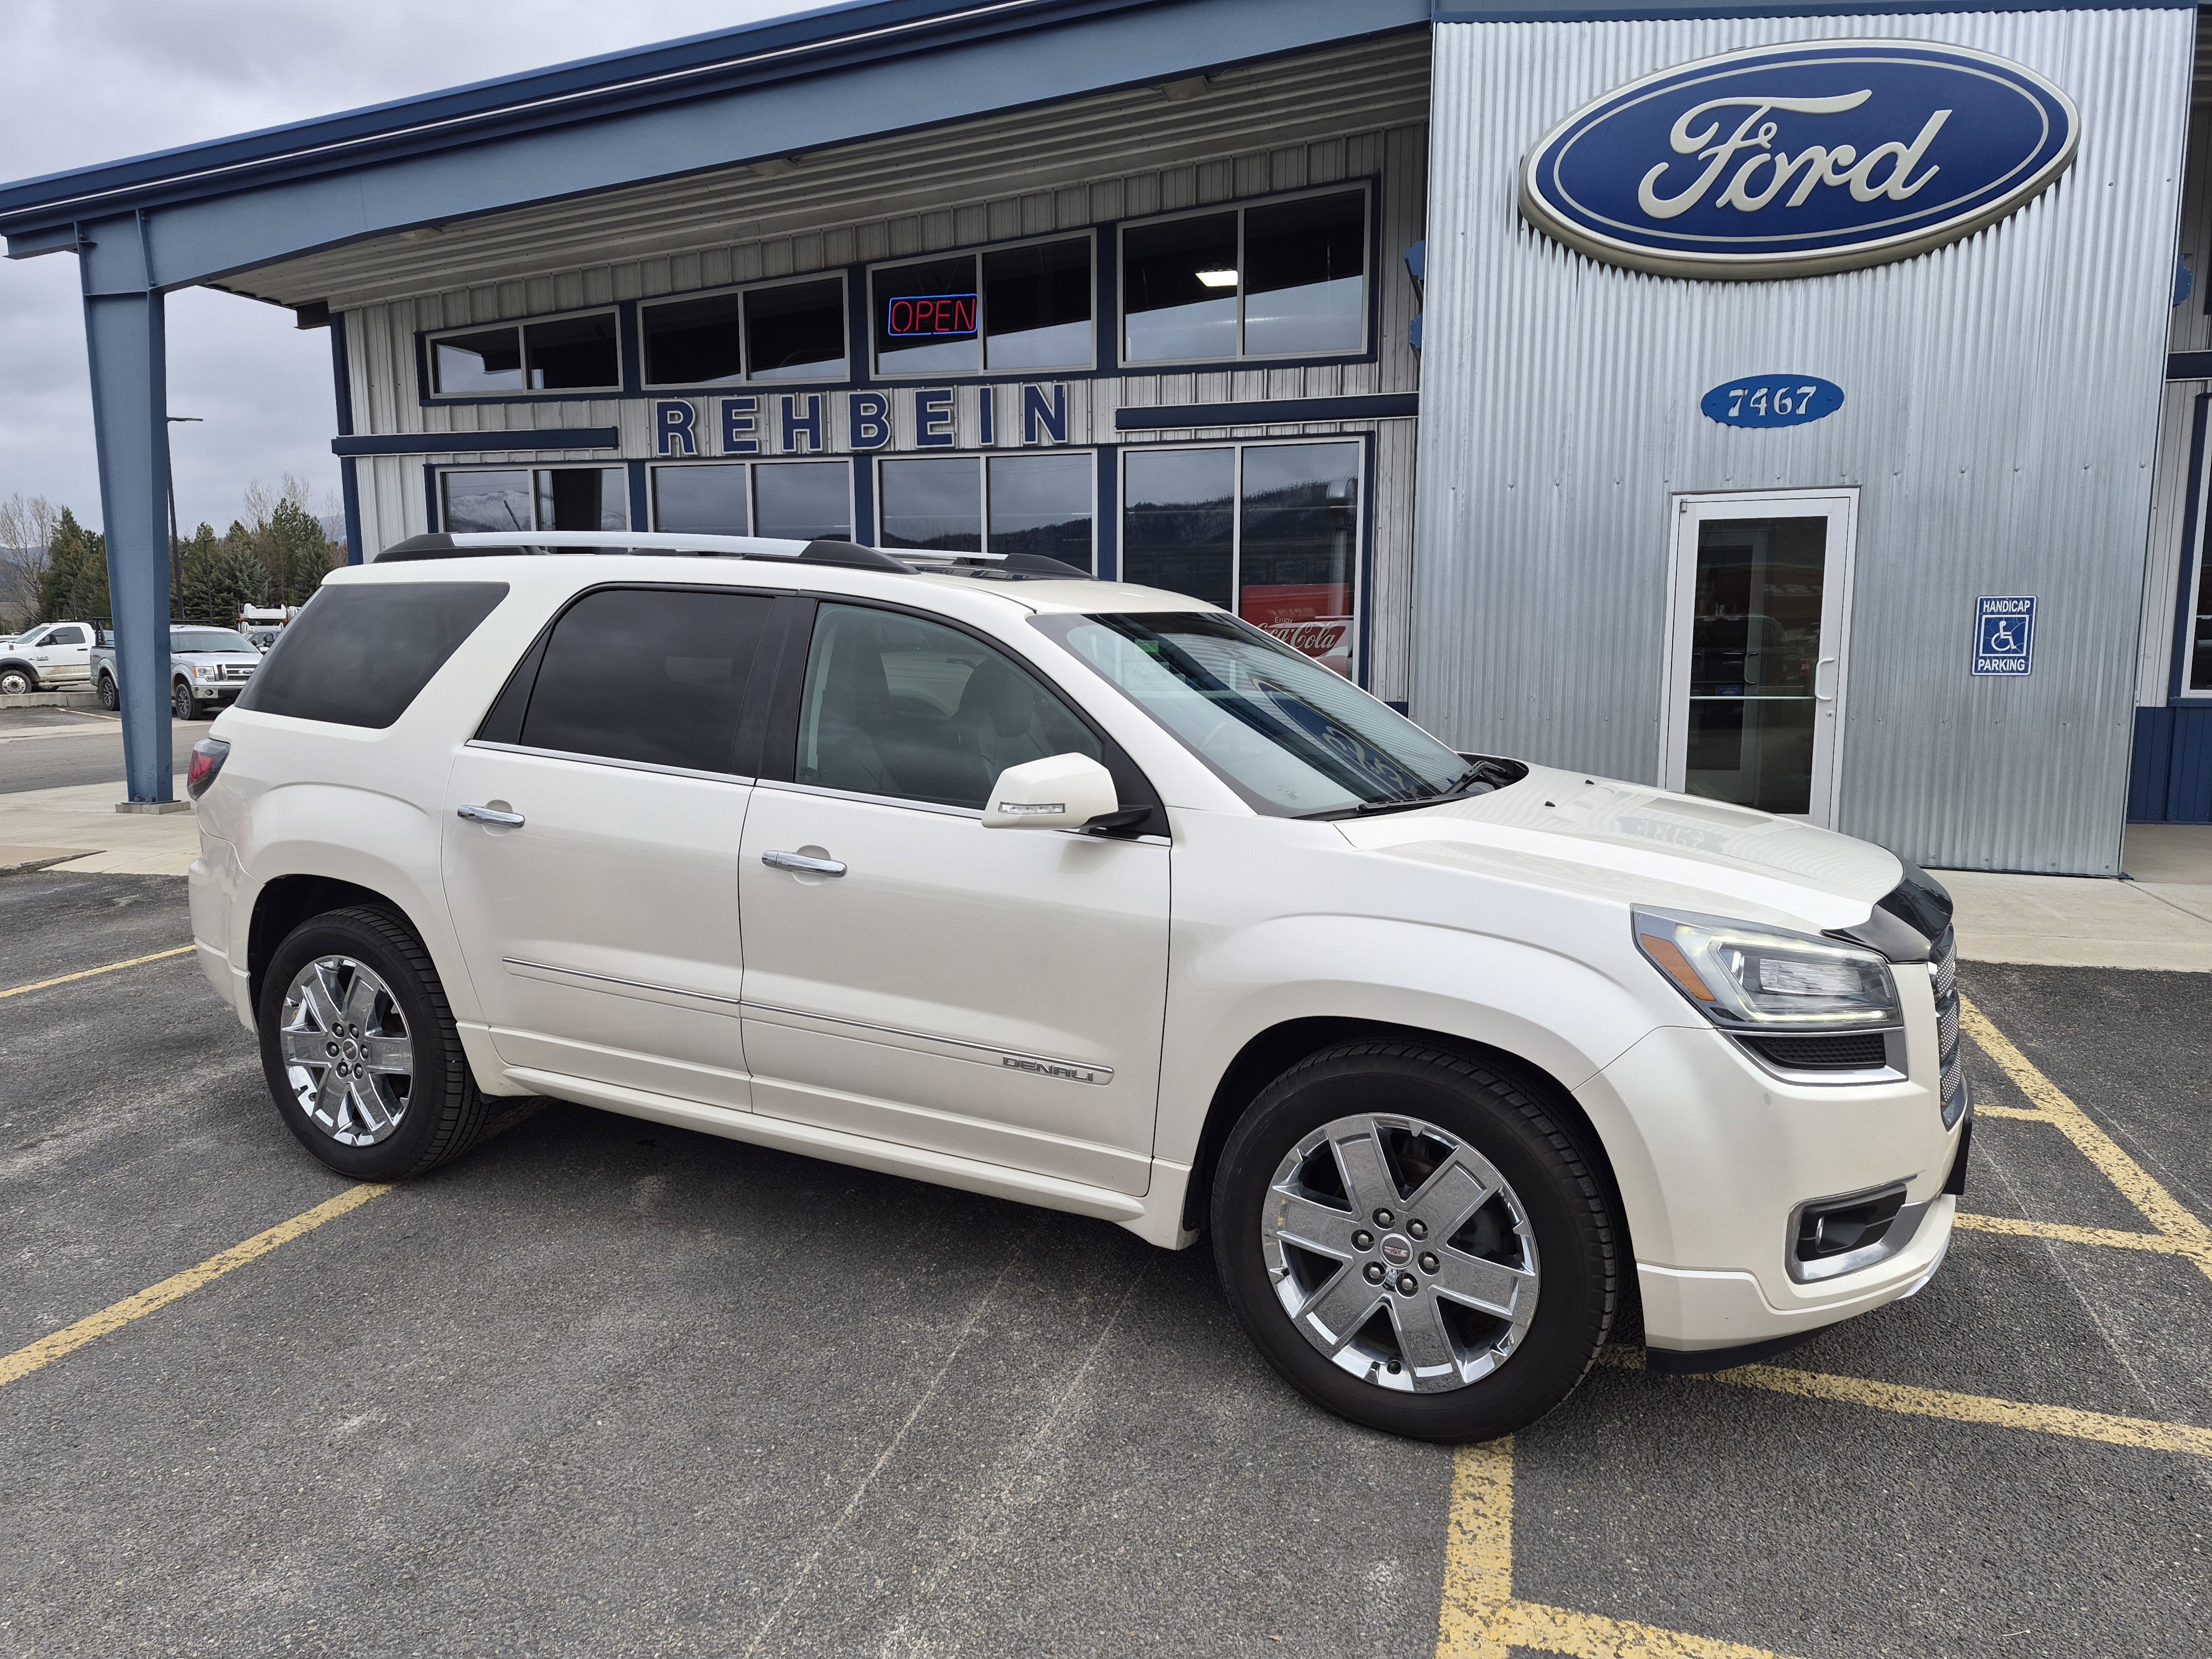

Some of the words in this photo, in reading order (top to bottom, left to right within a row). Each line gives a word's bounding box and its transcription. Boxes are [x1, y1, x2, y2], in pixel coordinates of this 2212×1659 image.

[1638, 88, 1953, 218] Ford
[891, 299, 977, 333] OPEN
[1726, 385, 1818, 416] 7467
[655, 382, 1068, 456] REHBEIN
[1983, 600, 2031, 612] HANDICAP
[1978, 659, 2026, 671] PARKING
[1003, 1055, 1093, 1082] DENALI
